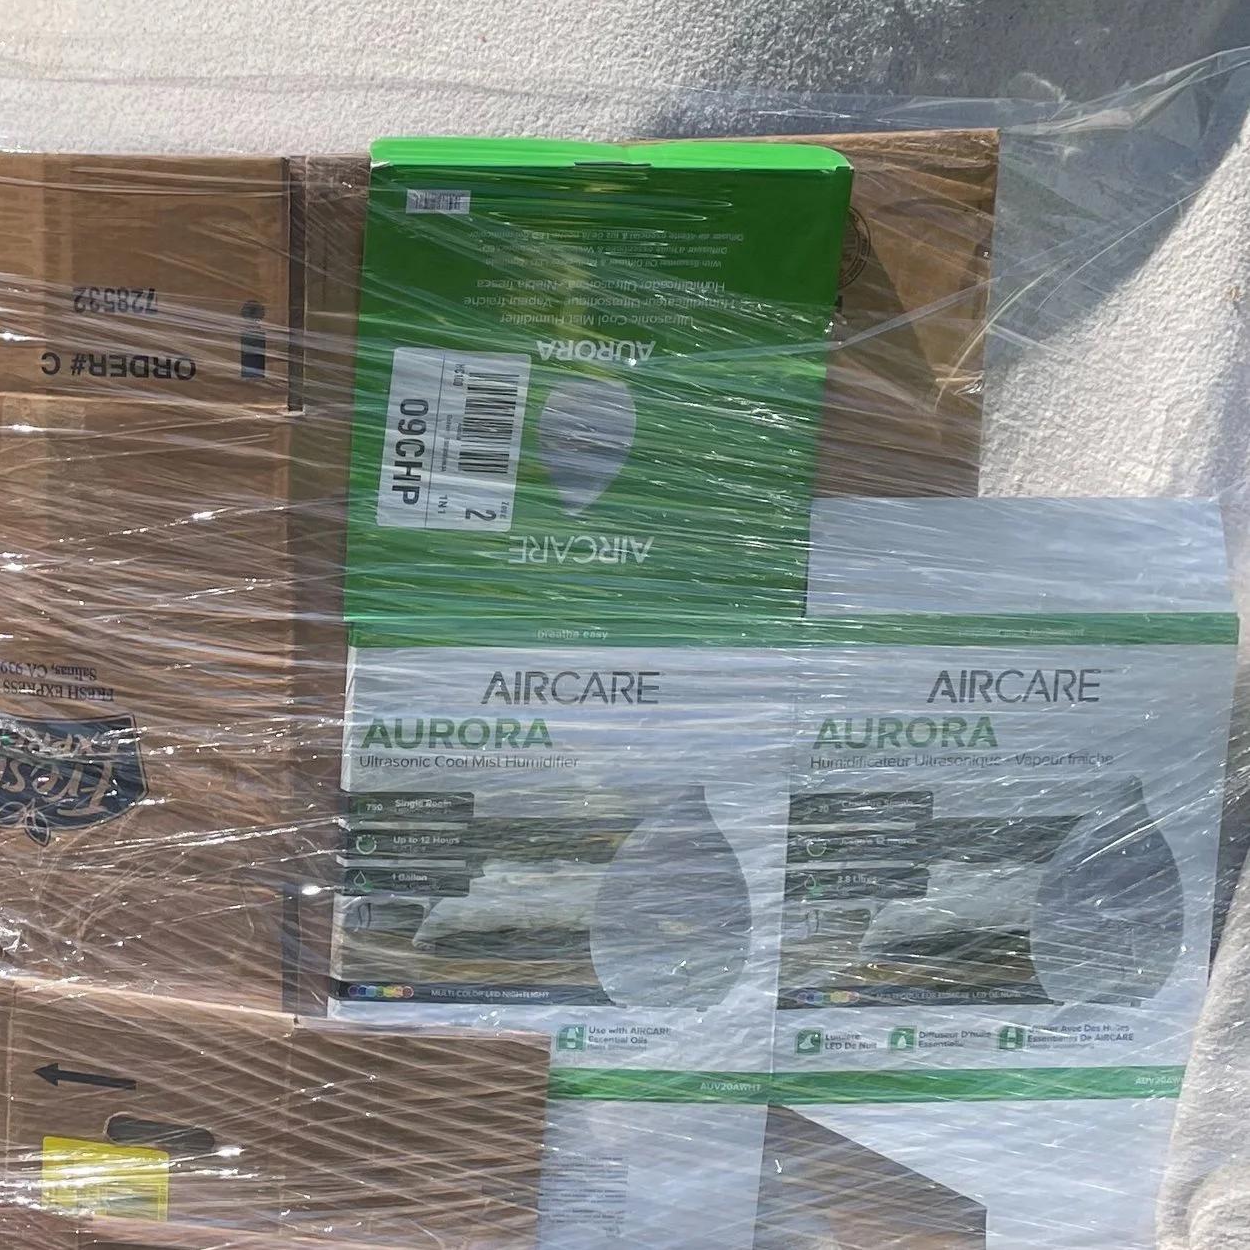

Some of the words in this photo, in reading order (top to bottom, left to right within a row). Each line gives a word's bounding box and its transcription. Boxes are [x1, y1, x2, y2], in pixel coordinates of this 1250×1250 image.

[73, 287, 158, 314] 728532
[500, 313, 565, 325] Humidifier
[569, 313, 595, 325] Mist
[598, 313, 627, 326] Cool
[536, 340, 656, 361] AURORA
[41, 352, 61, 375] C
[70, 353, 197, 380] ORDER#
[392, 399, 429, 505] 09CHP
[465, 508, 497, 522] 2
[508, 535, 655, 564] AIRCARE
[537, 629, 580, 640] breathe
[583, 631, 608, 640] easy
[28, 664, 48, 678] CA
[3, 681, 66, 699] EXPRESS
[481, 670, 660, 705] AIRCARE
[927, 669, 1101, 703] AIRCARE
[68, 685, 115, 701] FRESH
[360, 717, 553, 750] AURORA
[812, 716, 998, 750] AURORA
[359, 755, 430, 768] Ultrasonic
[435, 755, 468, 768] Cool
[473, 755, 501, 768] Mist
[505, 755, 578, 768] Humidifier
[810, 754, 911, 769] Humidificateur
[914, 753, 1001, 769] Ultrasonique
[1015, 753, 1066, 768] Vapeur
[366, 803, 383, 811] 750
[395, 799, 423, 808] Single
[393, 836, 406, 845] Up
[433, 836, 460, 844] Hours
[398, 873, 428, 881] Gallon
[485, 990, 501, 998] LED
[589, 1026, 606, 1034] Use
[609, 1026, 628, 1034] with
[631, 1027, 671, 1035] AIRCARE
[919, 1030, 958, 1039] Diffuseur
[1084, 1024, 1101, 1032] Des
[588, 1035, 628, 1044] Essential
[631, 1036, 648, 1044] Oils
[1095, 1033, 1134, 1041] AIRCARE
[825, 1042, 841, 1050] LED
[844, 1042, 856, 1050] De
[859, 1041, 877, 1049] Nuit
[700, 1082, 762, 1092] AUV20AWHT
